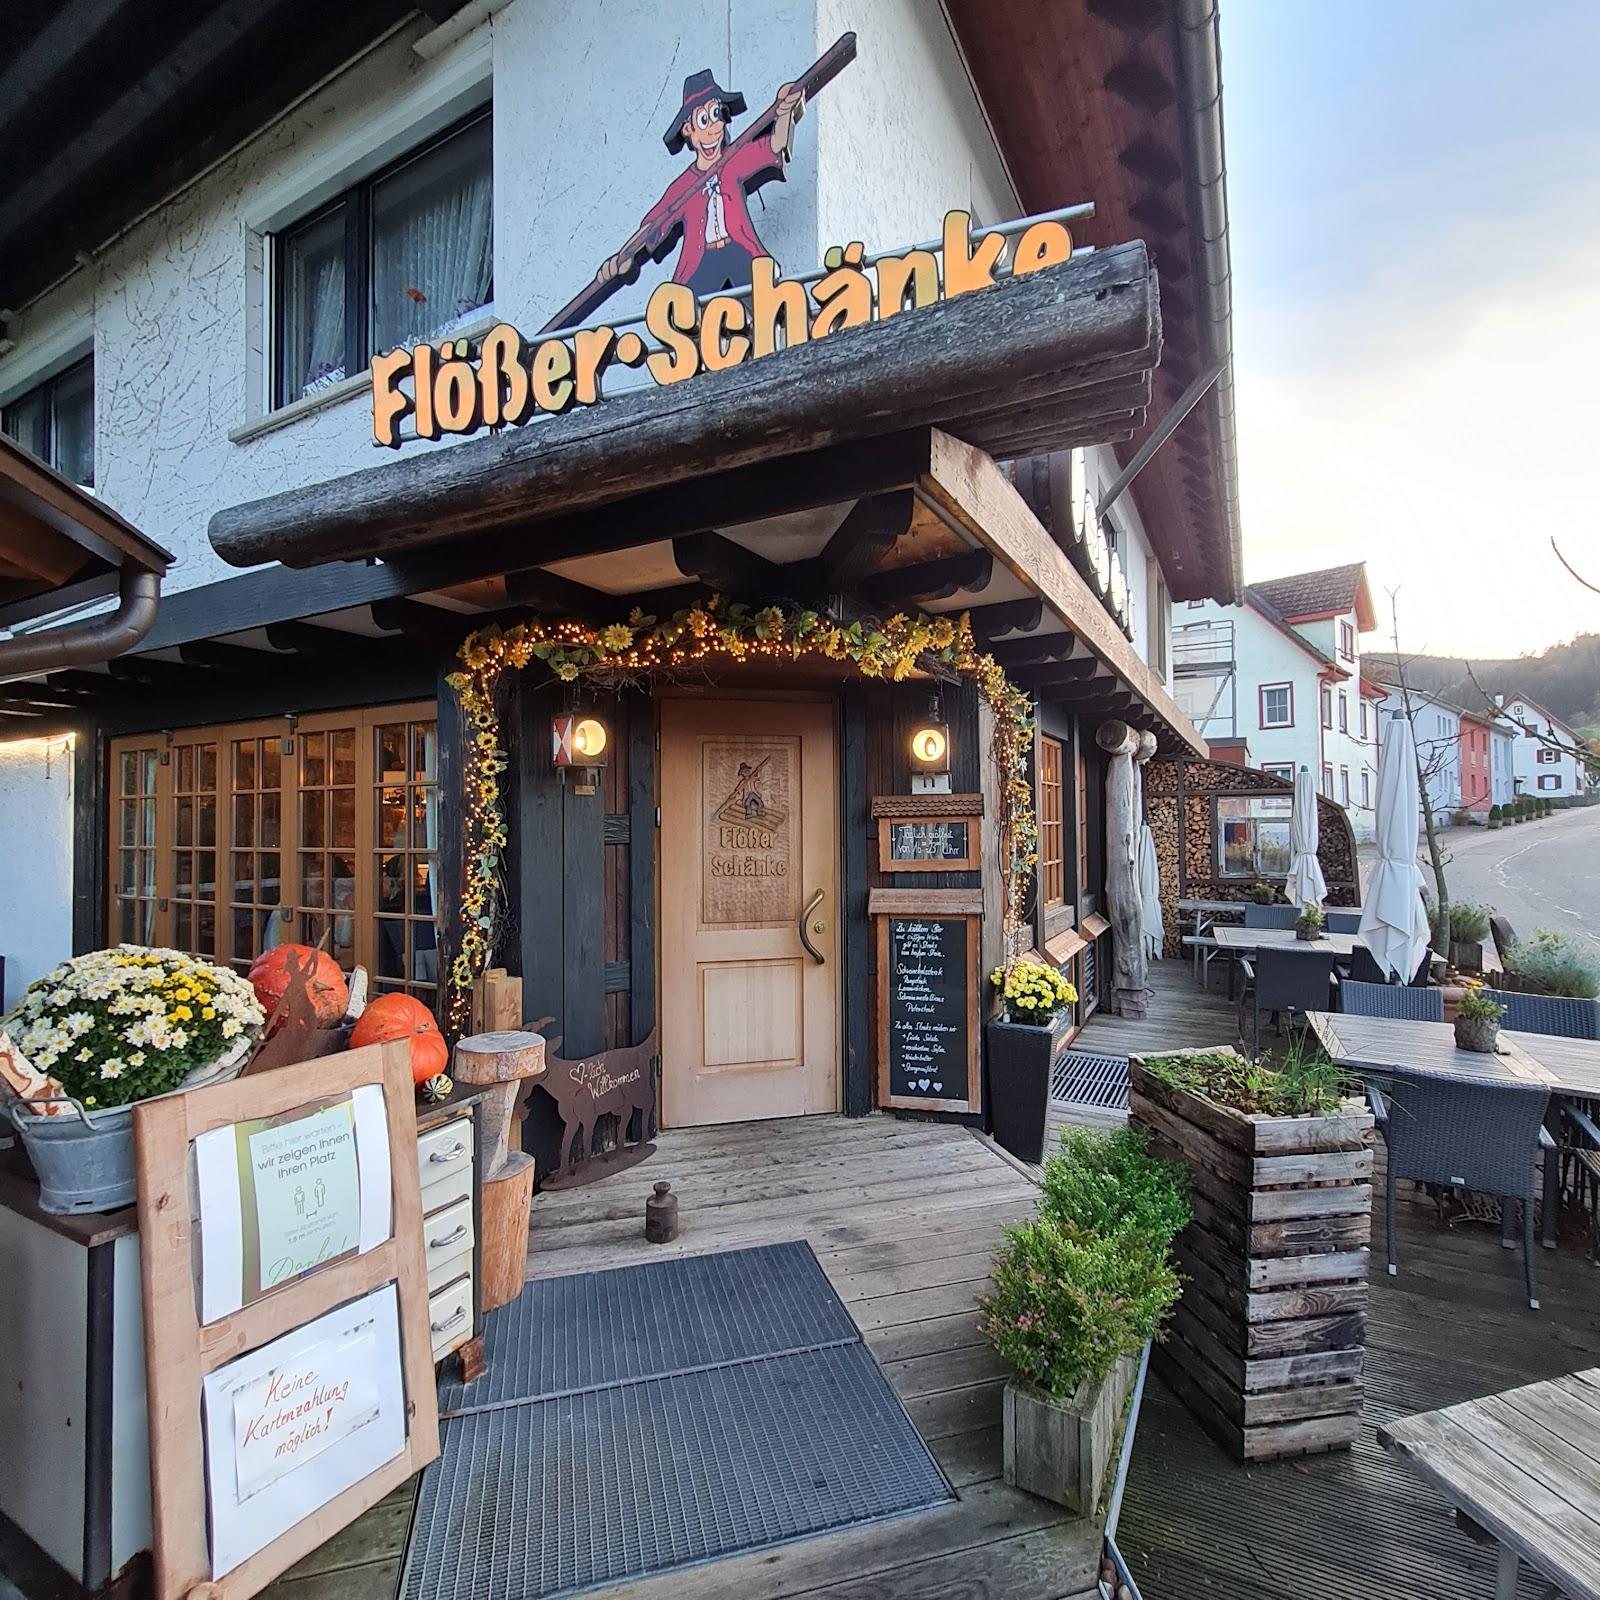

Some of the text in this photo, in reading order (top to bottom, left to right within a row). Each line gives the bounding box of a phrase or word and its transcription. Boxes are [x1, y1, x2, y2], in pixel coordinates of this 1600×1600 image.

[711, 854, 787, 877] Schänke
[587, 1069, 641, 1100] Willkommen
[258, 1132, 350, 1170] wir zeigen Ihnen
[278, 1151, 337, 1179] Ihren Platz
[265, 1369, 319, 1408] Keine
[243, 1381, 350, 1448] Kartenzahlung
